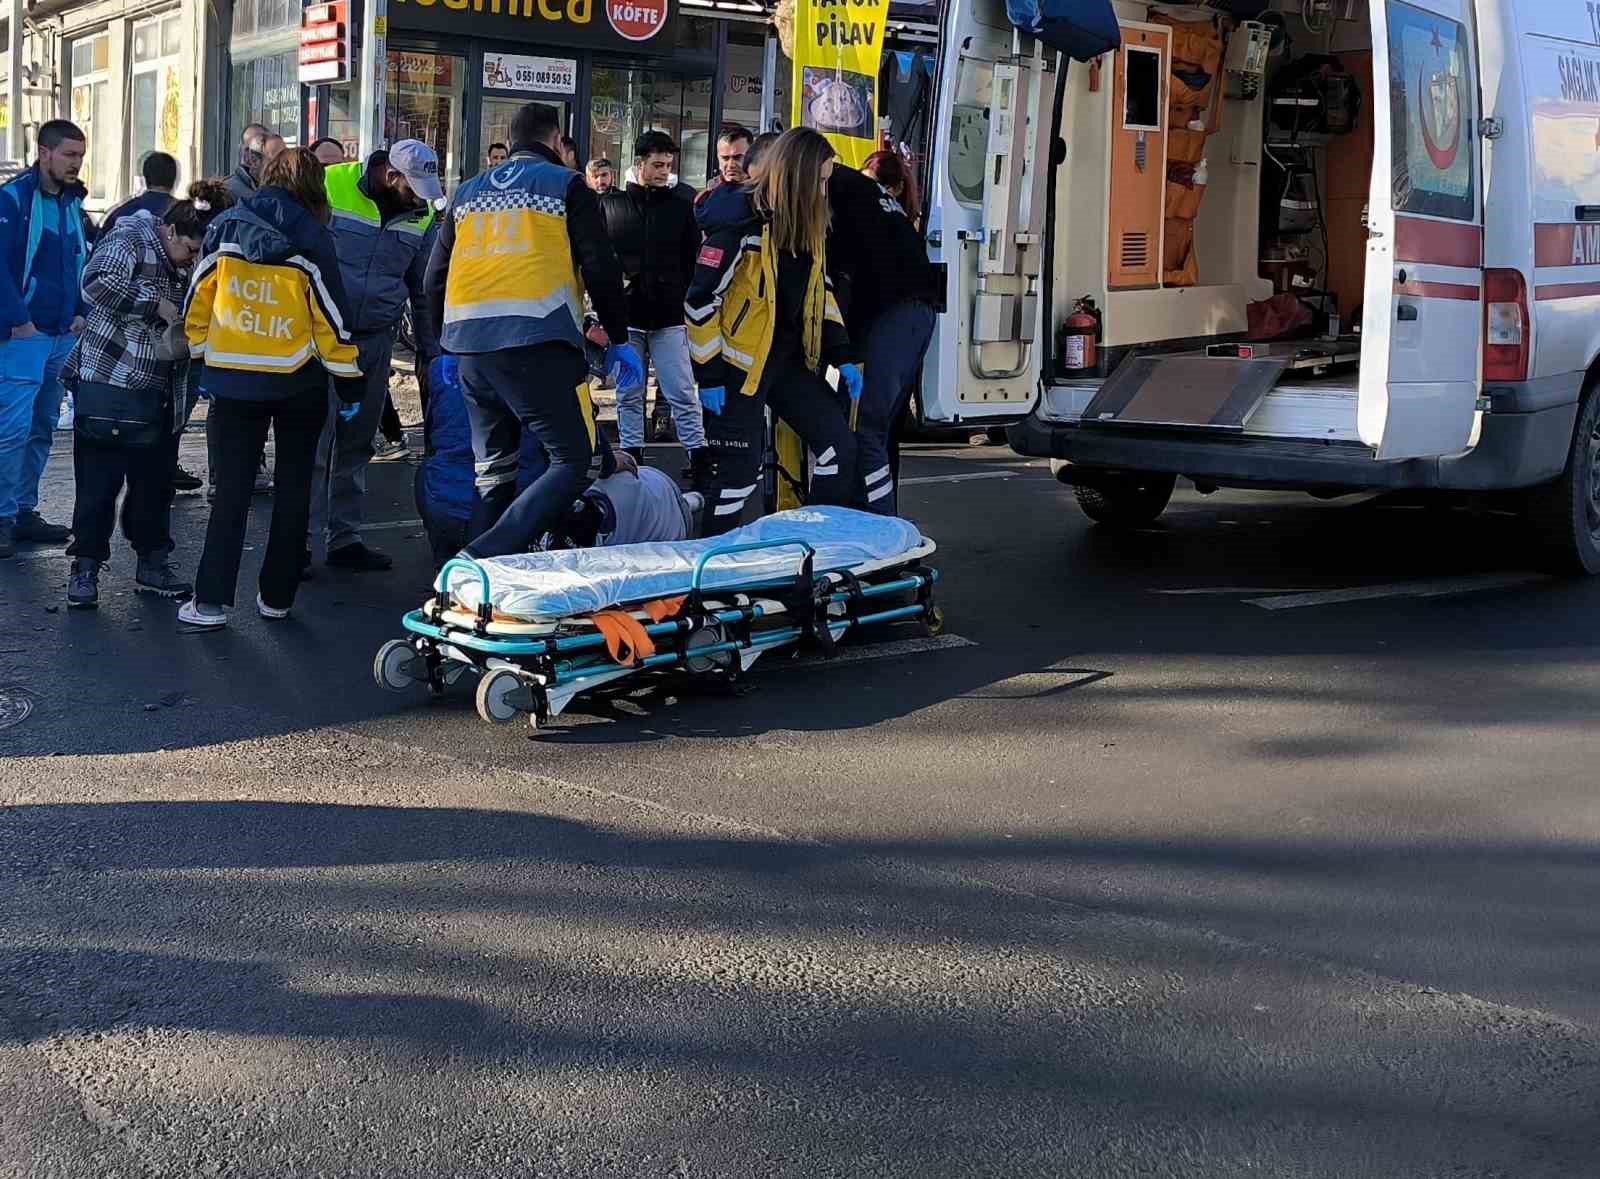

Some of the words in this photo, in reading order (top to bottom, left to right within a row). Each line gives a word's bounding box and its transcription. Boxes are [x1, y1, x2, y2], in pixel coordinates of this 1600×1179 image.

[613, 1, 658, 24] KÖFTE
[229, 275, 279, 304] ACİL
[217, 303, 295, 339] AĞLIK
